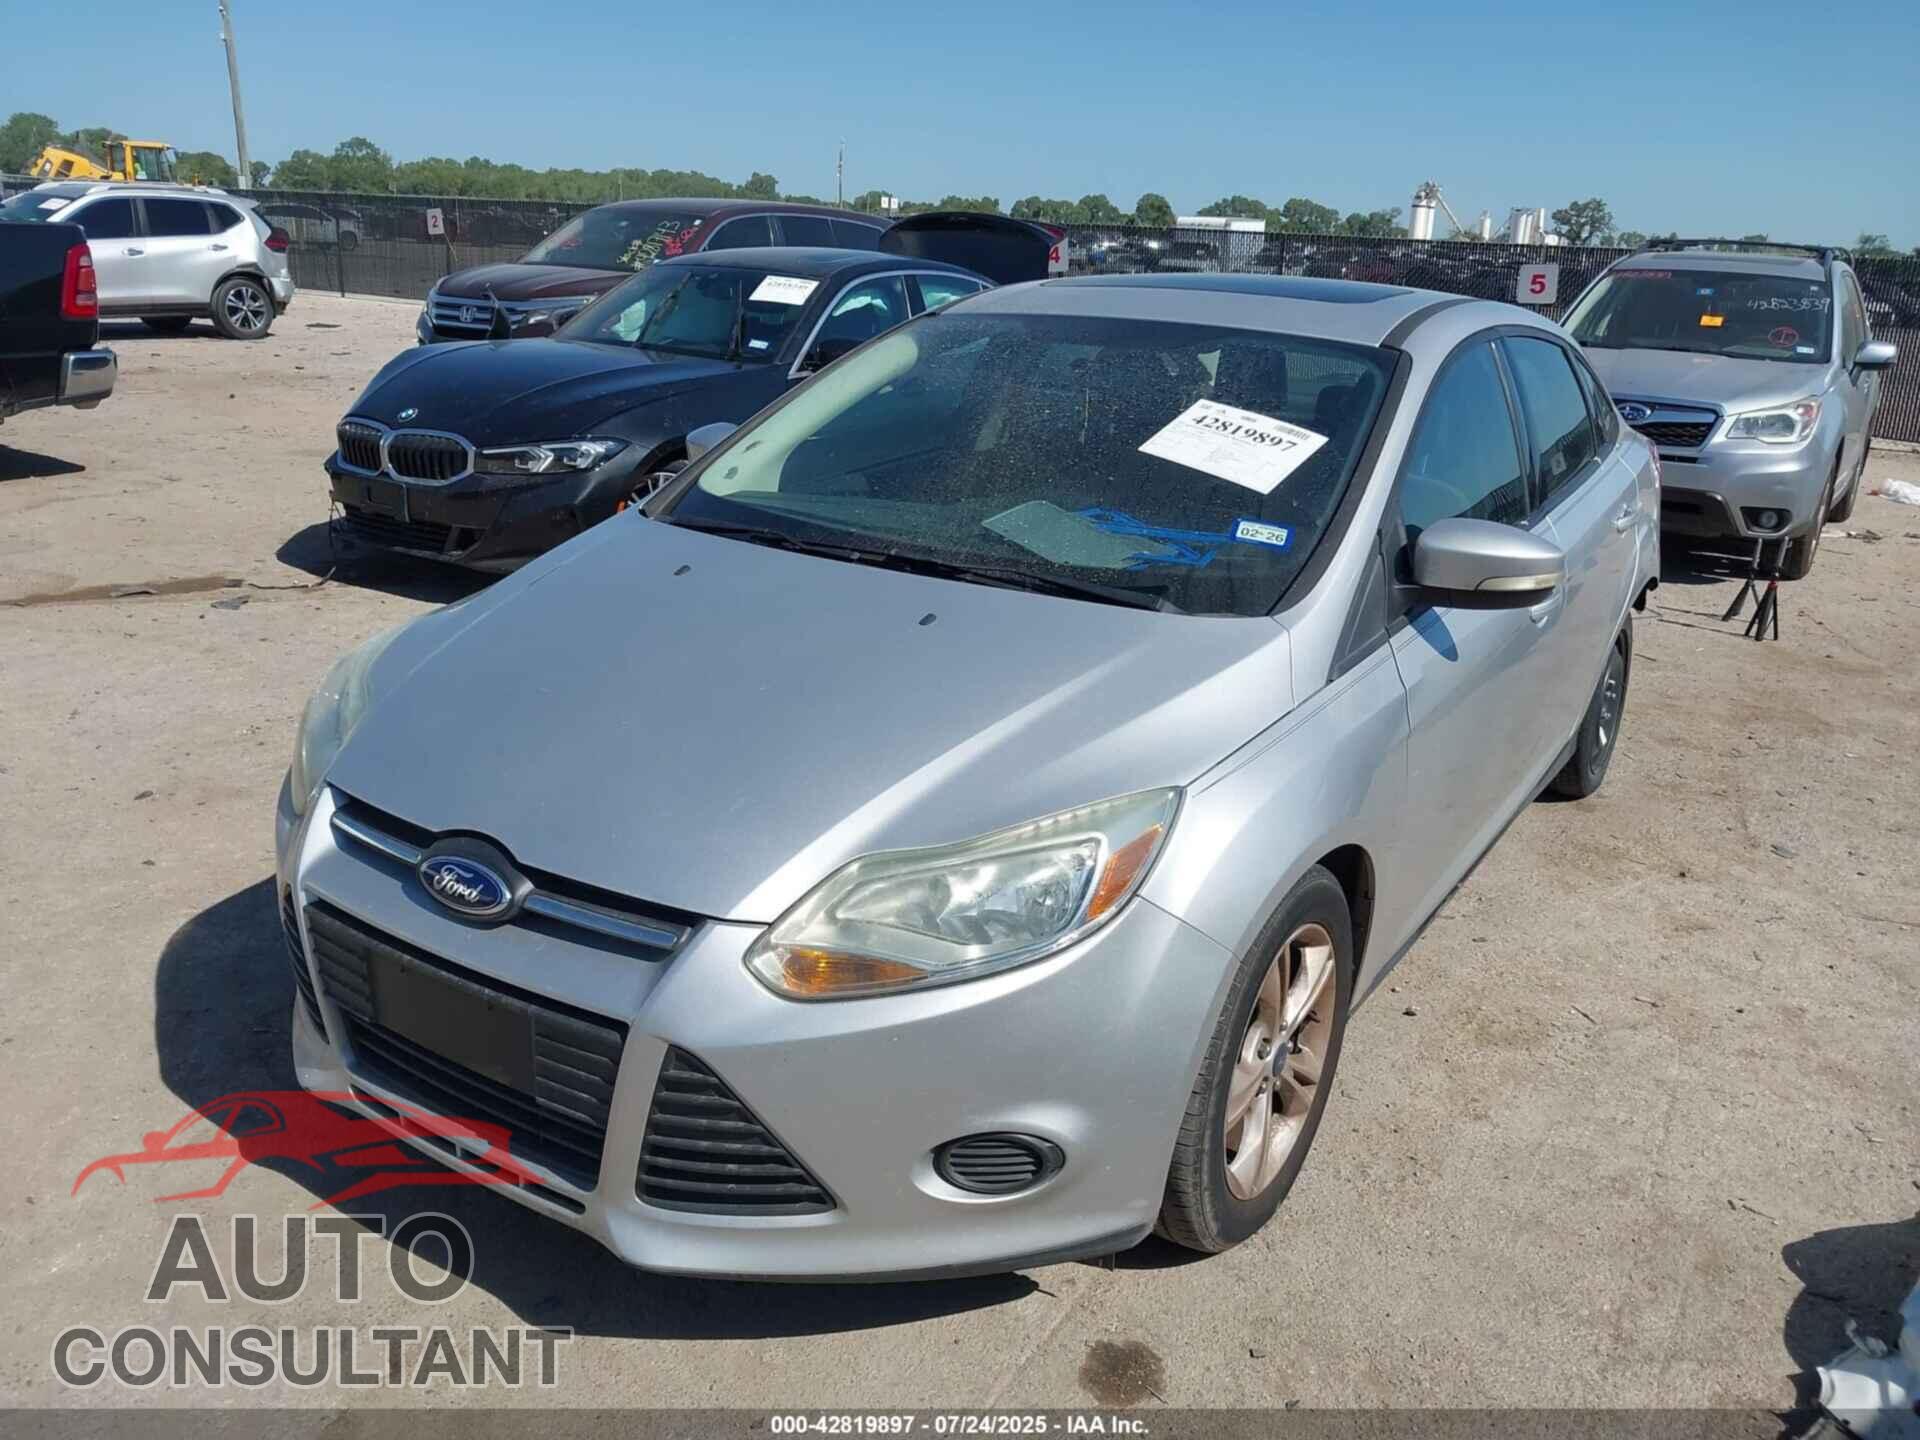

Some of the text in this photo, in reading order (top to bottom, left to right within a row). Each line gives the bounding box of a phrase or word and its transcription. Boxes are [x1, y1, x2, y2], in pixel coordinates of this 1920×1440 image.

[431, 215, 439, 228] 2
[1050, 246, 1061, 264] 4
[1529, 273, 1546, 294] 5
[1192, 415, 1298, 452] 42819897
[1240, 526, 1284, 544] 02-26
[433, 864, 484, 903] Ford
